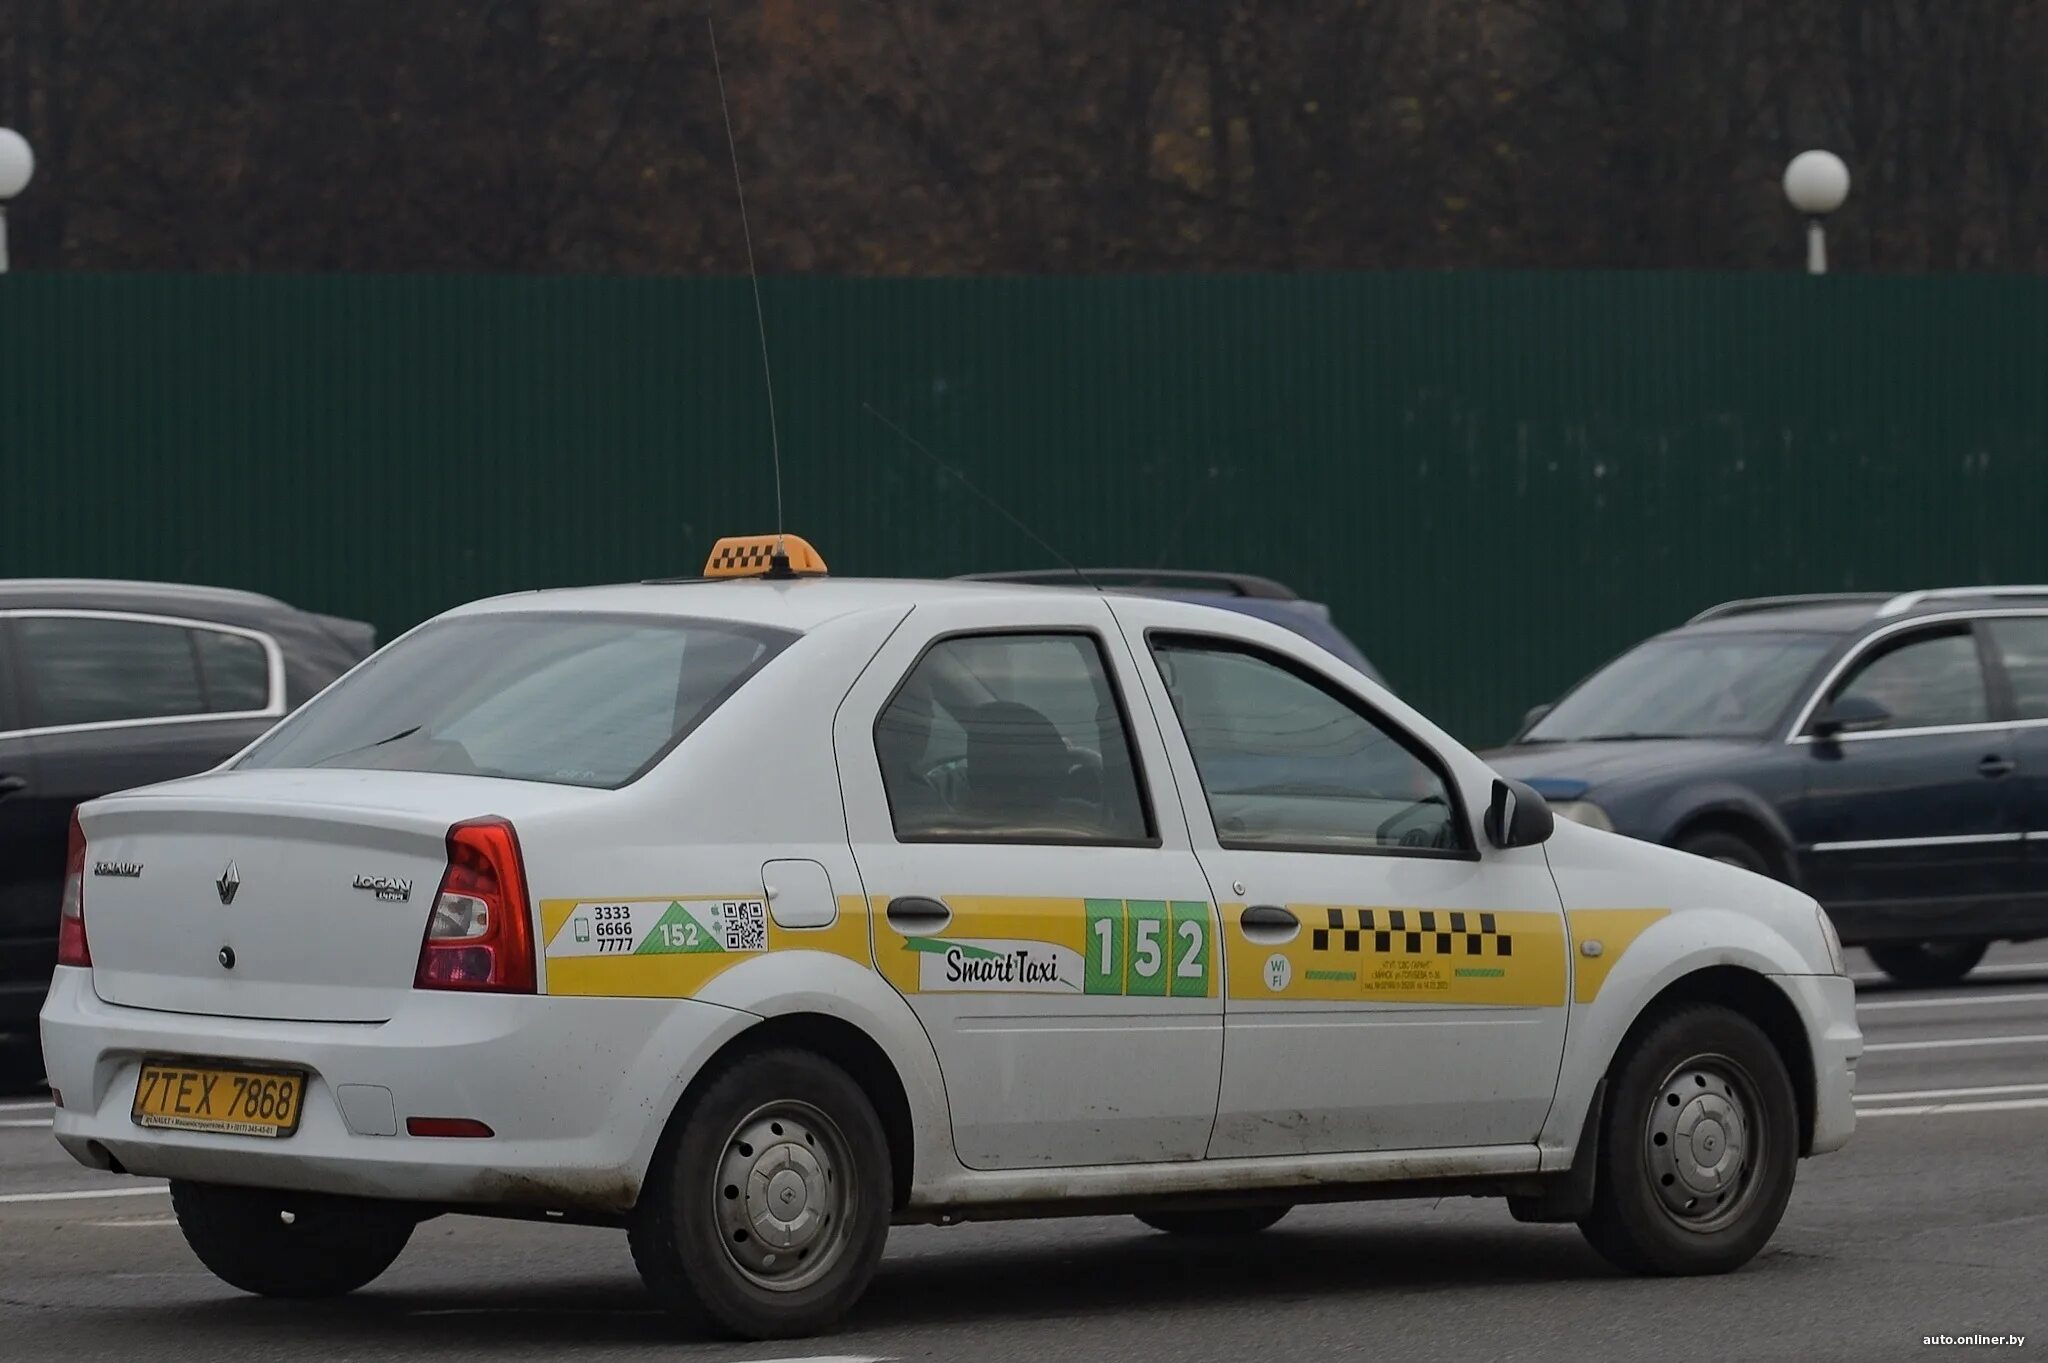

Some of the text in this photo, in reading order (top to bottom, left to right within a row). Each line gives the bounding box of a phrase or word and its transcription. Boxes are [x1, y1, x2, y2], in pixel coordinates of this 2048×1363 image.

[353, 874, 412, 893] LOGAN
[594, 906, 631, 920] 3333
[596, 922, 632, 936] 6666
[659, 923, 699, 947] 152
[597, 938, 633, 952] 7777
[140, 1070, 293, 1121] 7TEX 7868
